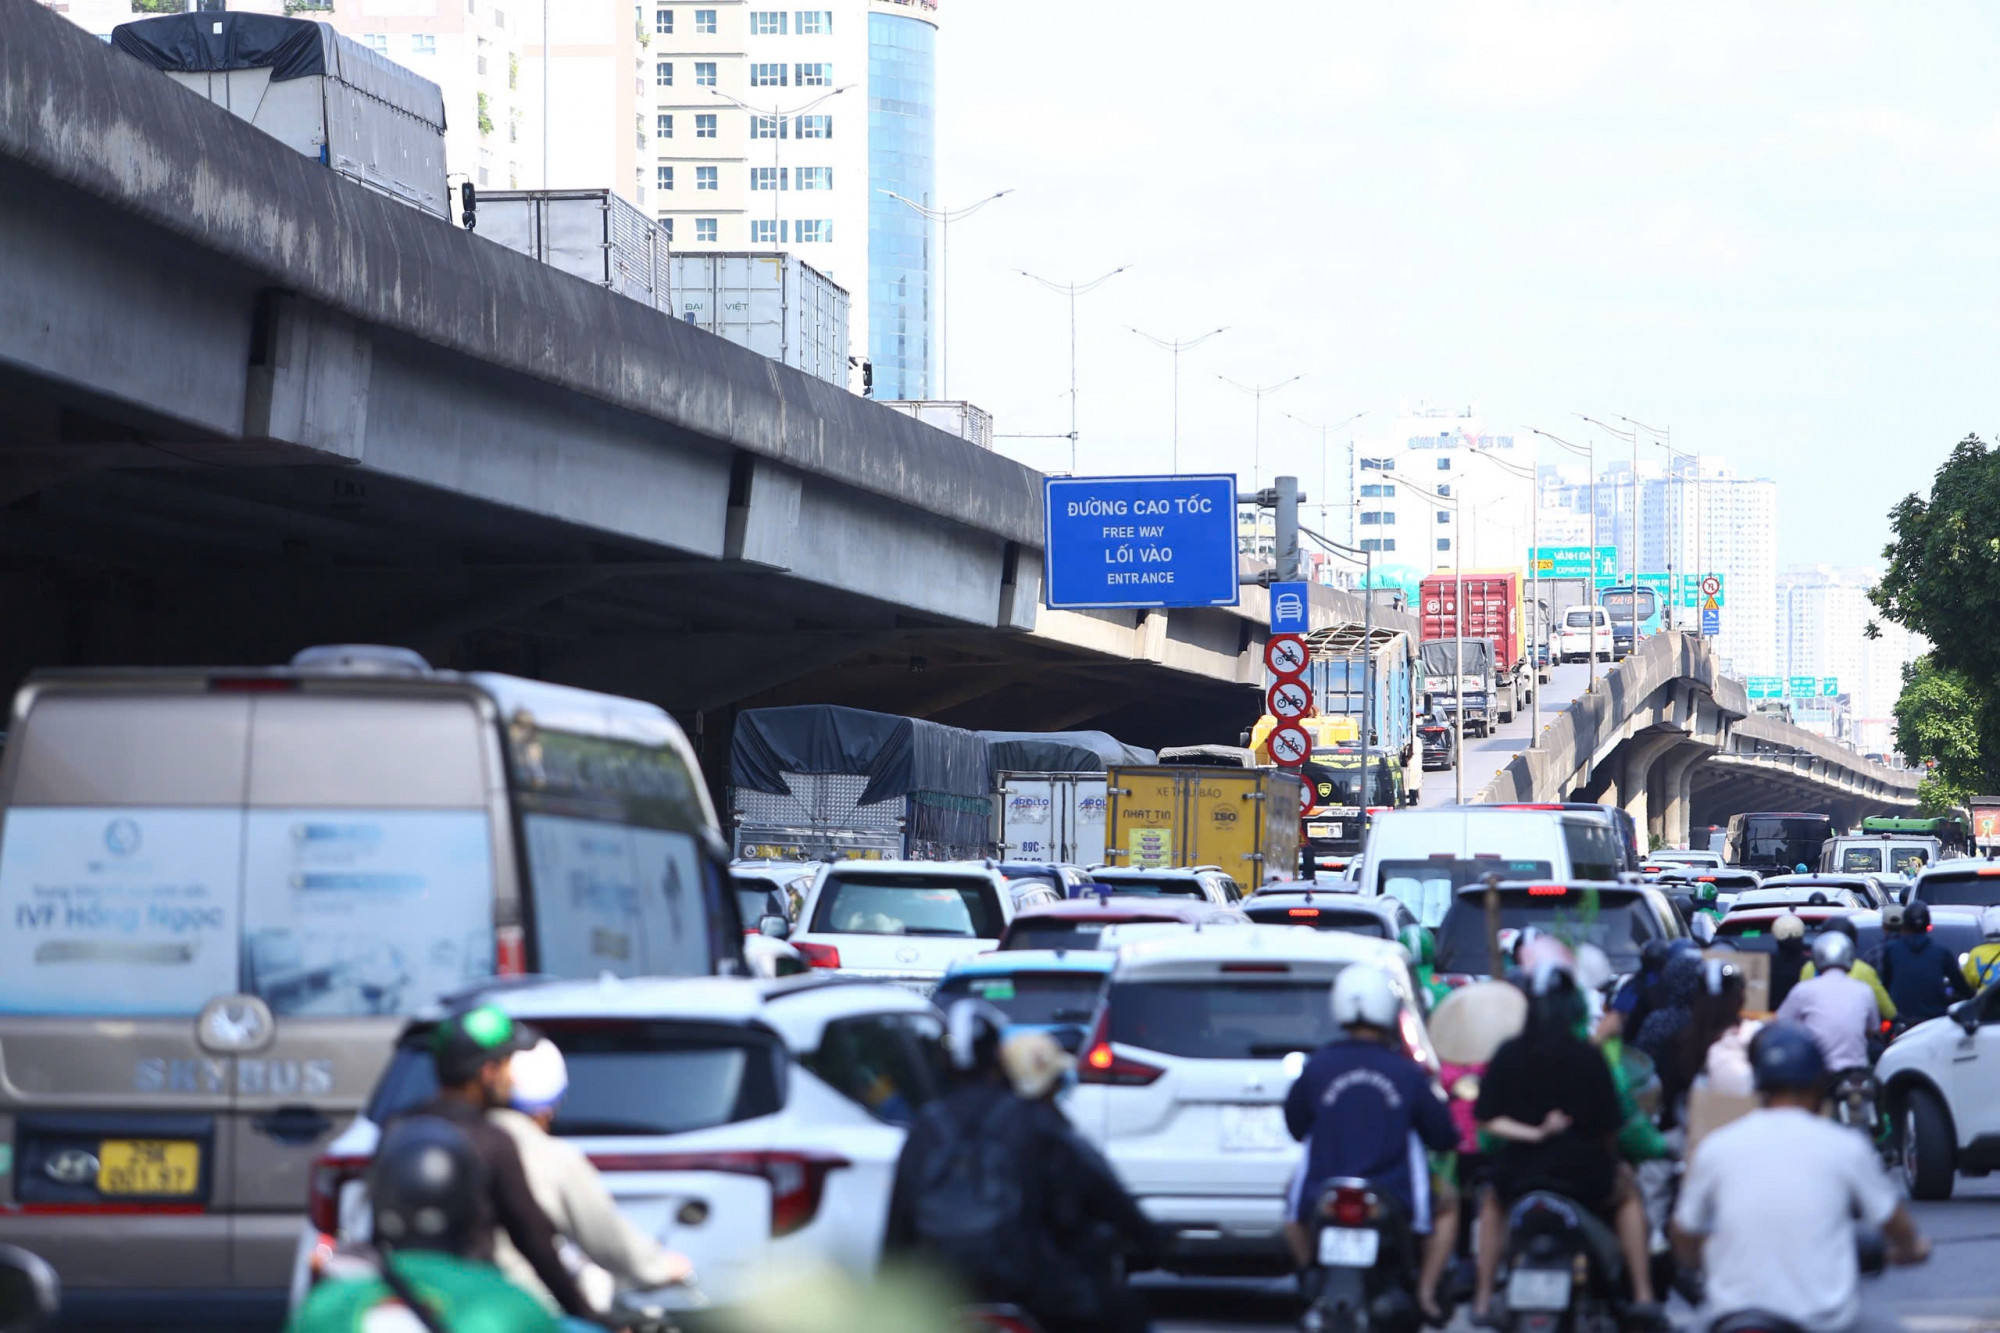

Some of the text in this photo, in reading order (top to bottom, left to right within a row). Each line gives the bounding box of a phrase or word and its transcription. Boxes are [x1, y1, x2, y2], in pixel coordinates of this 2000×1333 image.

[725, 301, 749, 313] VIỆT
[1068, 494, 1212, 516] ĐƯỜNG CAO TỐC
[1103, 526, 1164, 538] FREE WAY
[1105, 543, 1172, 563] LỐI VÀO
[1107, 572, 1175, 585] ENTRANCE
[1157, 787, 1169, 797] XE
[1214, 812, 1236, 820] ISO
[1022, 841, 1040, 852] 89C
[16, 904, 54, 927] IVF
